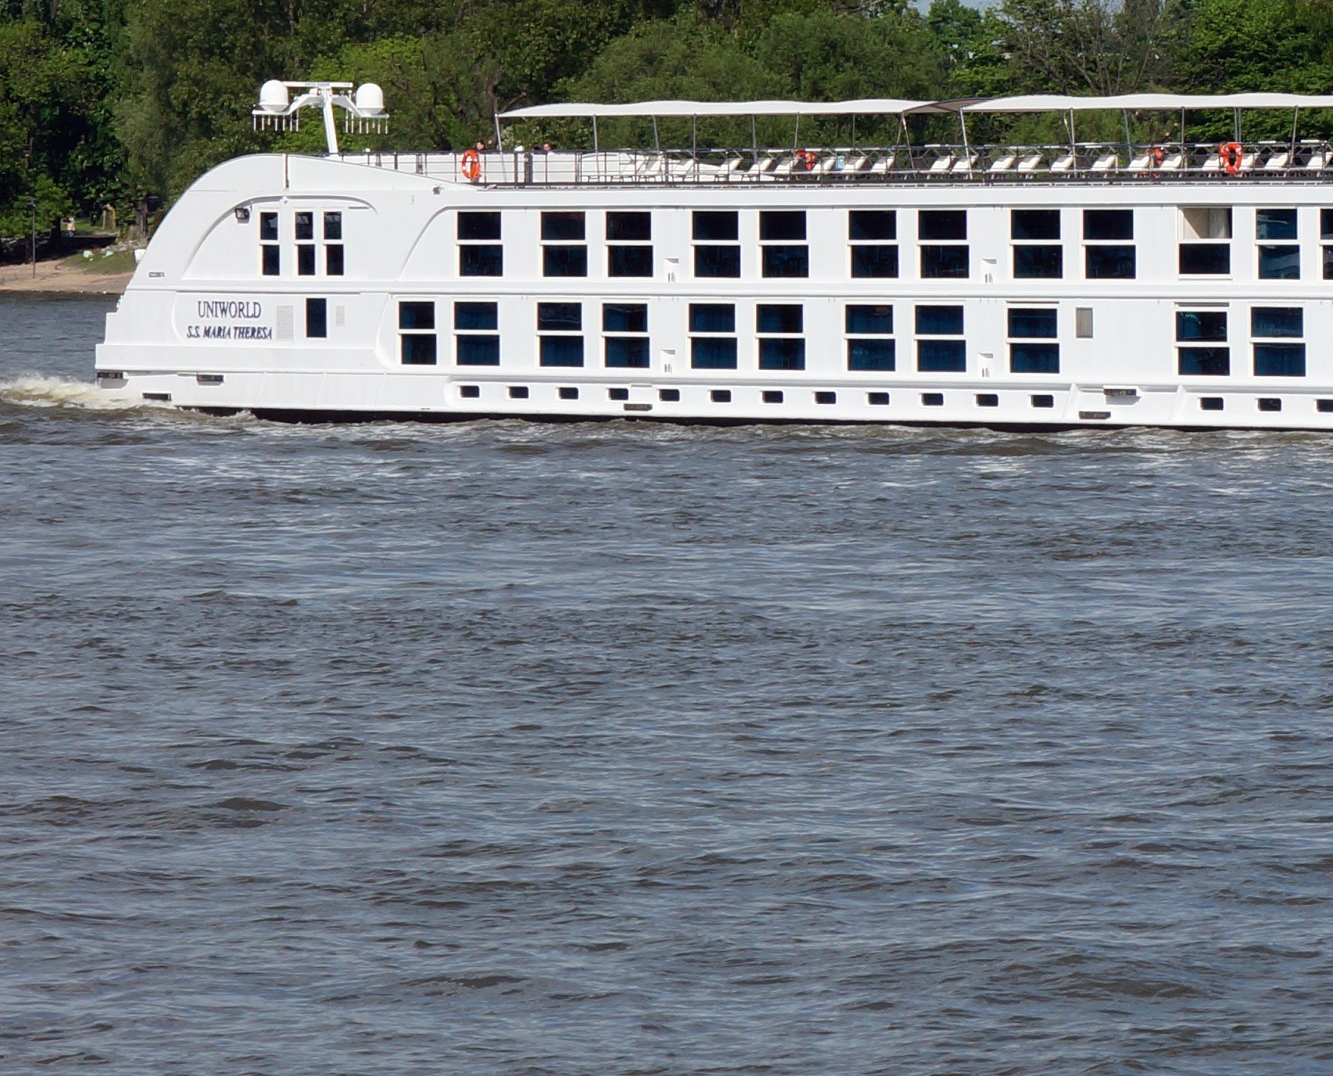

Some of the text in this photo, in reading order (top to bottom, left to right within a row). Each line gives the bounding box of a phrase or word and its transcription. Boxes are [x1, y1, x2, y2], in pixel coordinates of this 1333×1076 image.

[197, 301, 261, 319] UNIWORLD
[203, 326, 231, 339] MARIA
[233, 326, 272, 340] THERESA
